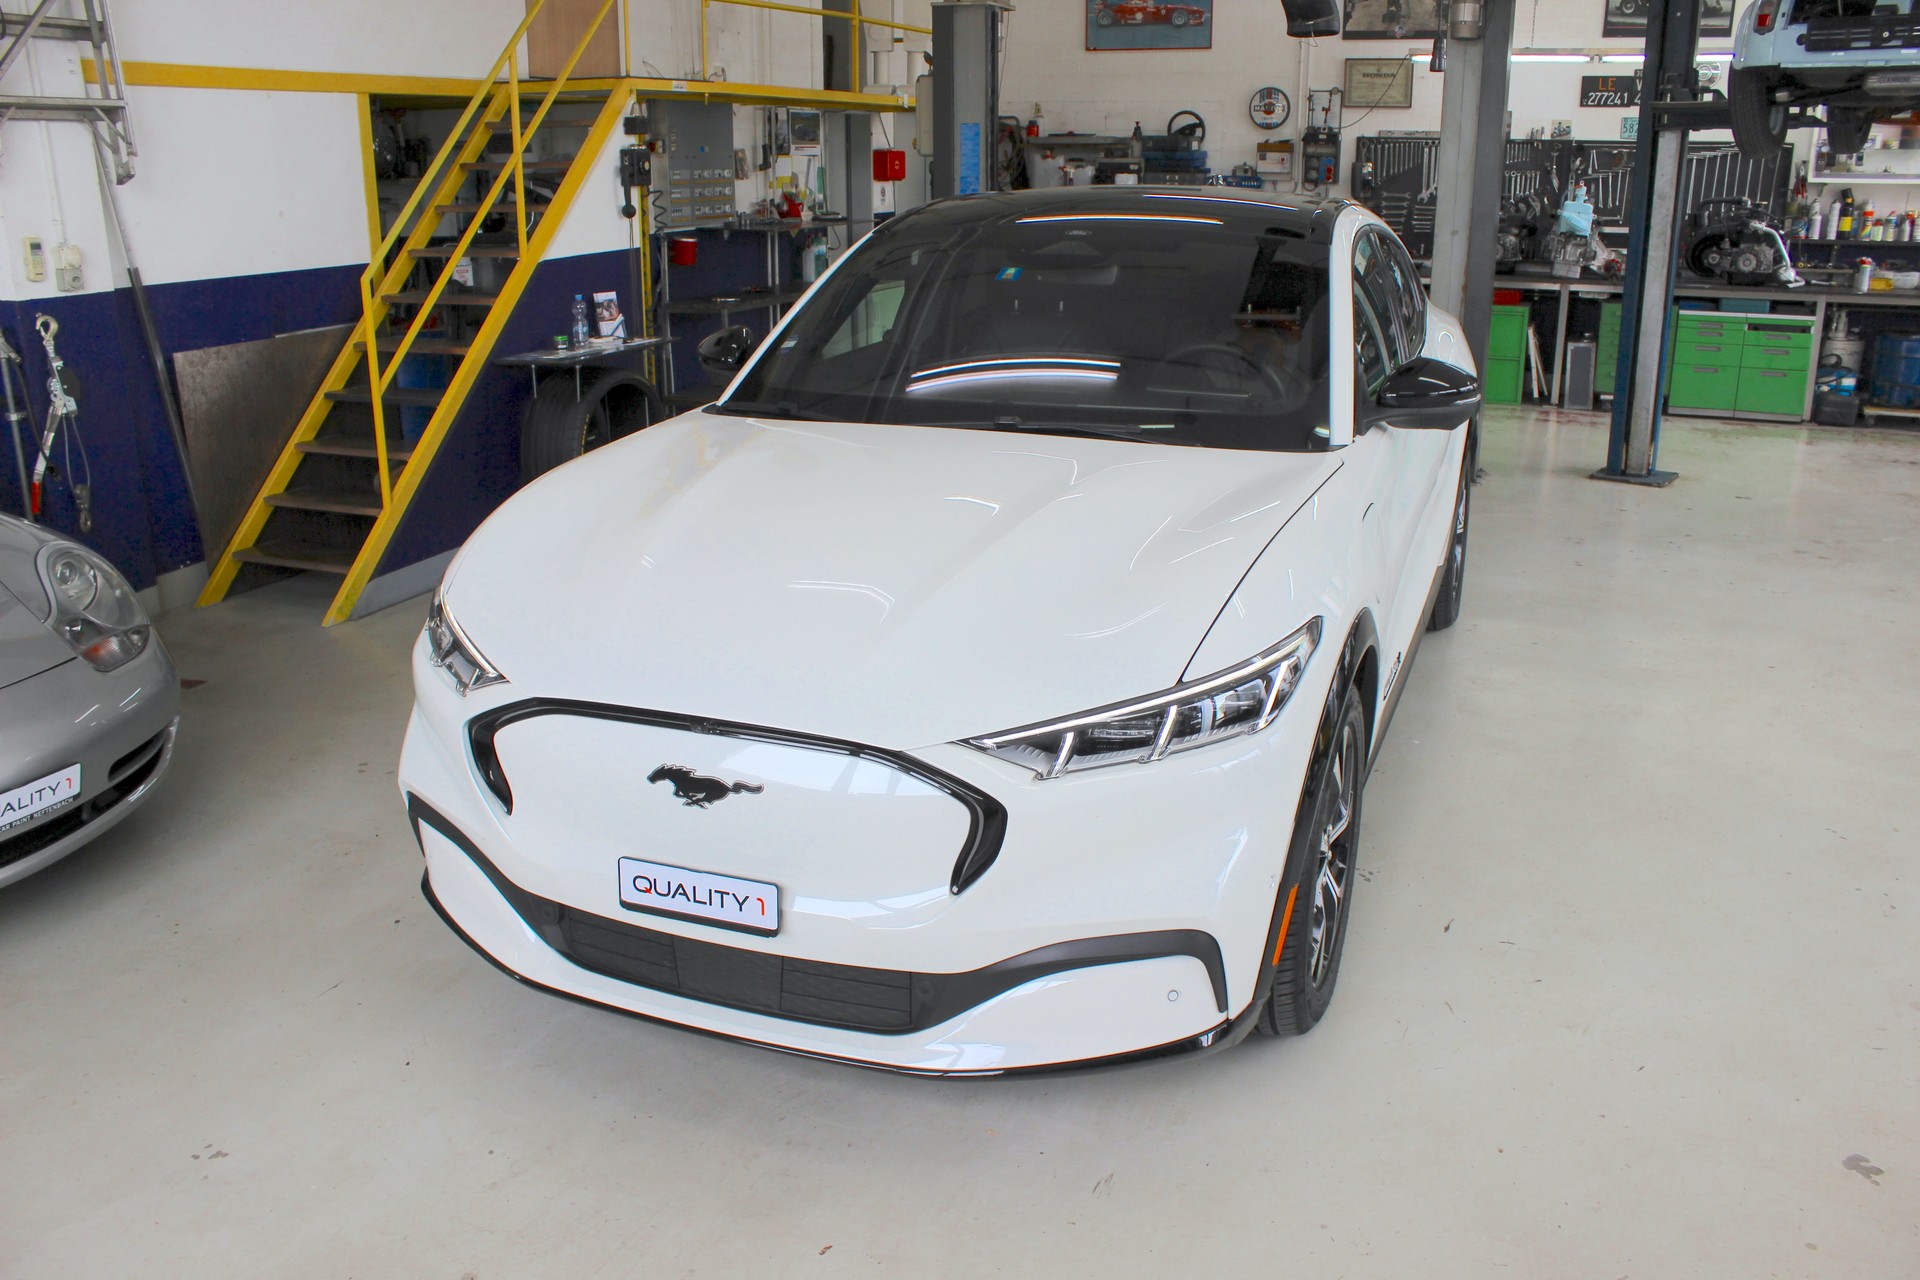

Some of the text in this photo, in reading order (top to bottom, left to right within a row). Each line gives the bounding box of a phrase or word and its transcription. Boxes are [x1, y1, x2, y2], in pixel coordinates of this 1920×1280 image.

[1599, 77, 1617, 91] LE
[1587, 92, 1628, 105] 277241
[0, 777, 72, 818] ALITY 1
[12, 815, 31, 828] PAINT
[632, 874, 765, 916] QUALITY 1
